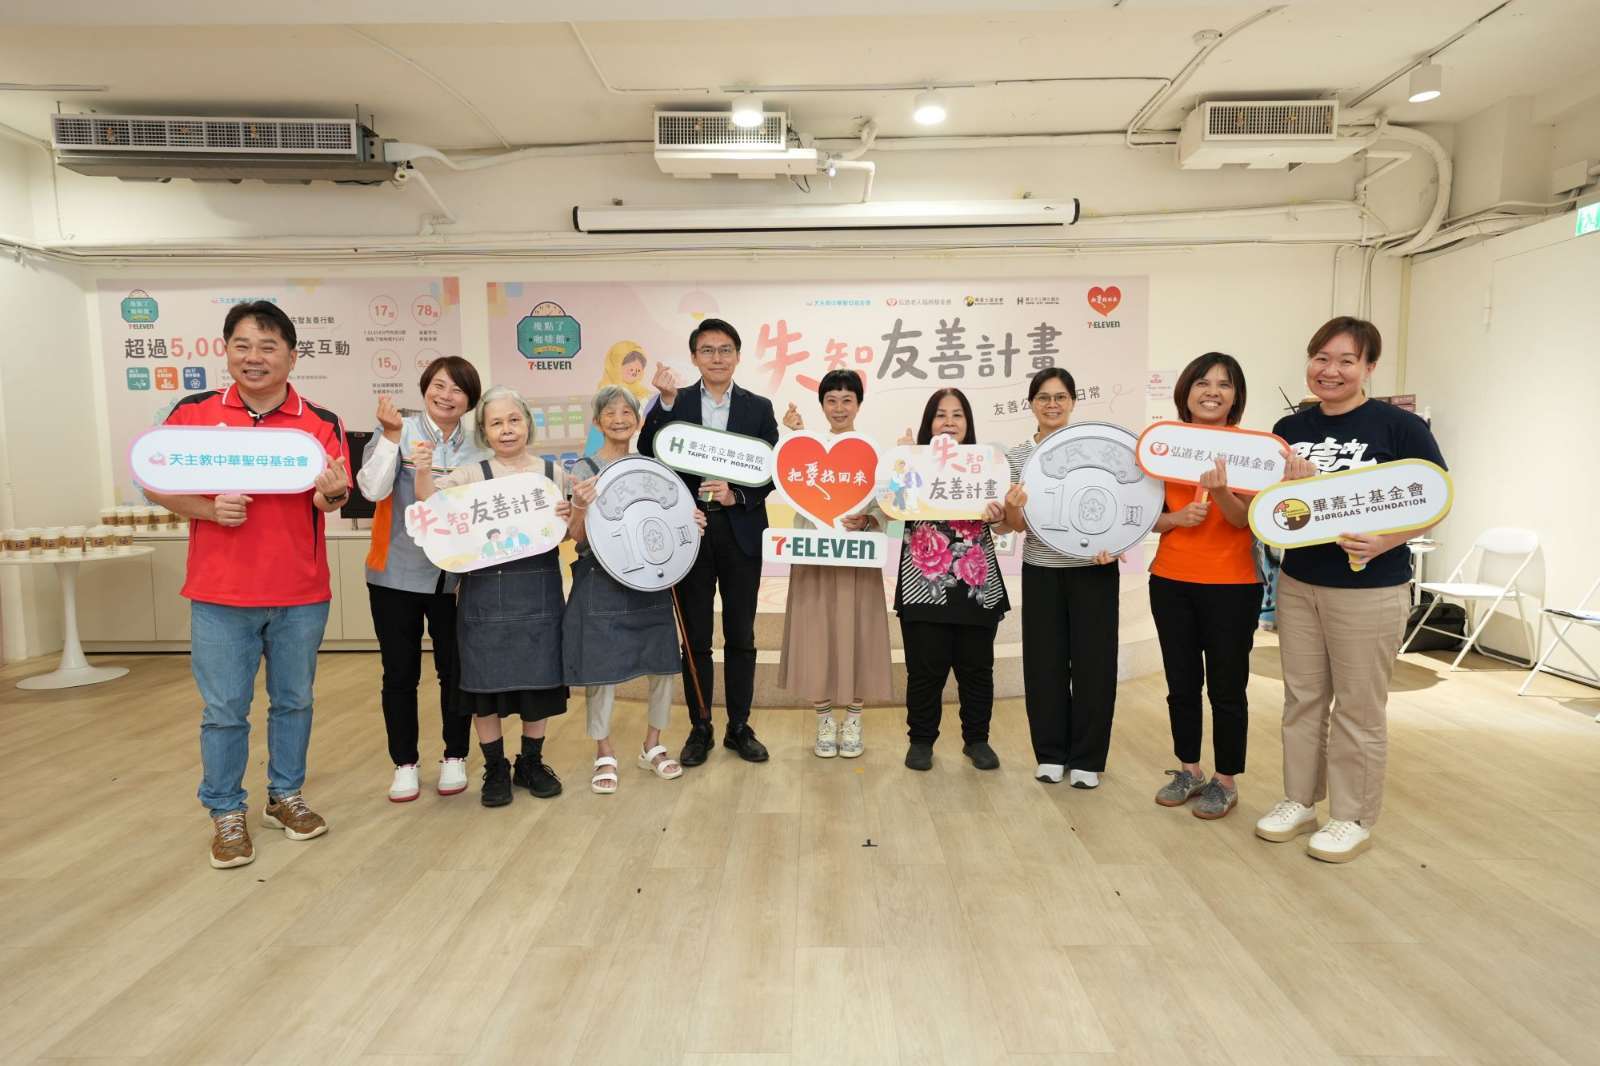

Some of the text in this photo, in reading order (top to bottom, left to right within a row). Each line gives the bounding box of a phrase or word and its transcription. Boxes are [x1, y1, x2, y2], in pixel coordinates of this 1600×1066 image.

[168, 452, 309, 468] 天主教中華聖母基金會
[687, 450, 763, 472] TAIPEI CITY HOSPITAL
[932, 437, 985, 475] 失智
[787, 461, 868, 500] 把愛找回來
[929, 477, 998, 500] 友善計畫
[1312, 482, 1424, 512] 畢嘉士基金會
[1314, 496, 1427, 522] BJØRGAAS FOUNDATION
